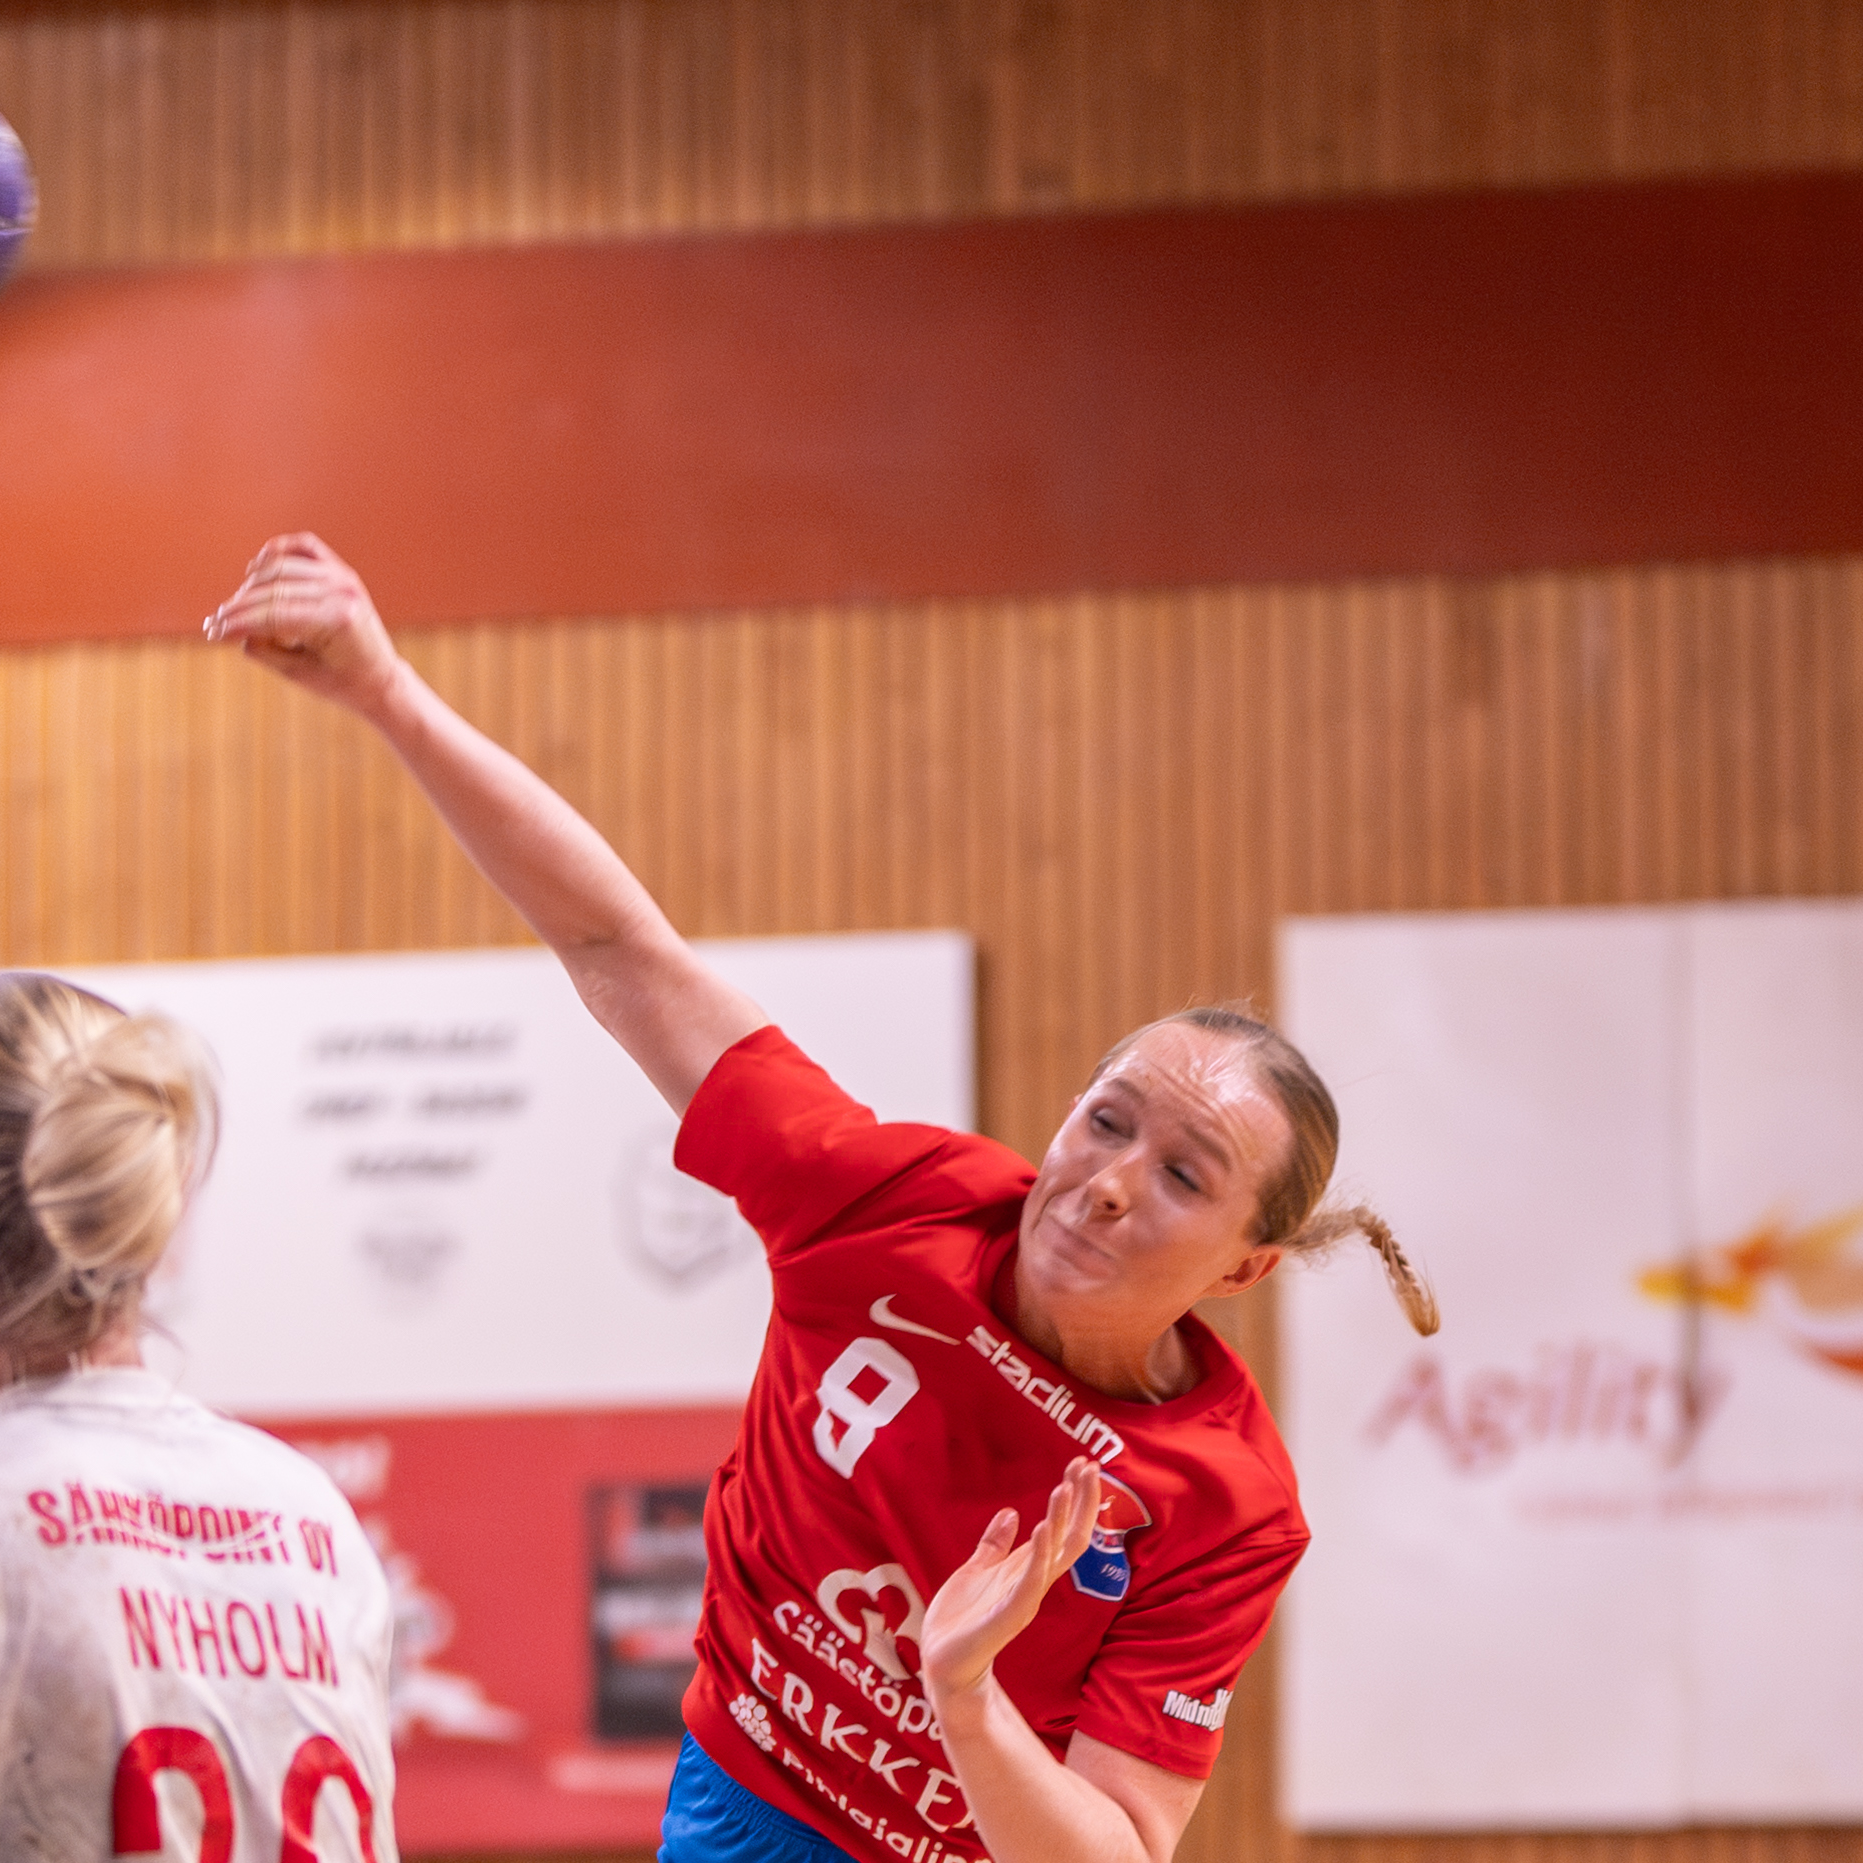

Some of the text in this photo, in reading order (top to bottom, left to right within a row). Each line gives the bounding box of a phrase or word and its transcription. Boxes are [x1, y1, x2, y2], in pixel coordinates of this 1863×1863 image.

[812, 1336, 920, 1480] 8
[965, 1324, 1125, 1465] stadium
[120, 1586, 339, 1688] NYHOLM
[750, 1637, 981, 1834] ERKKE
